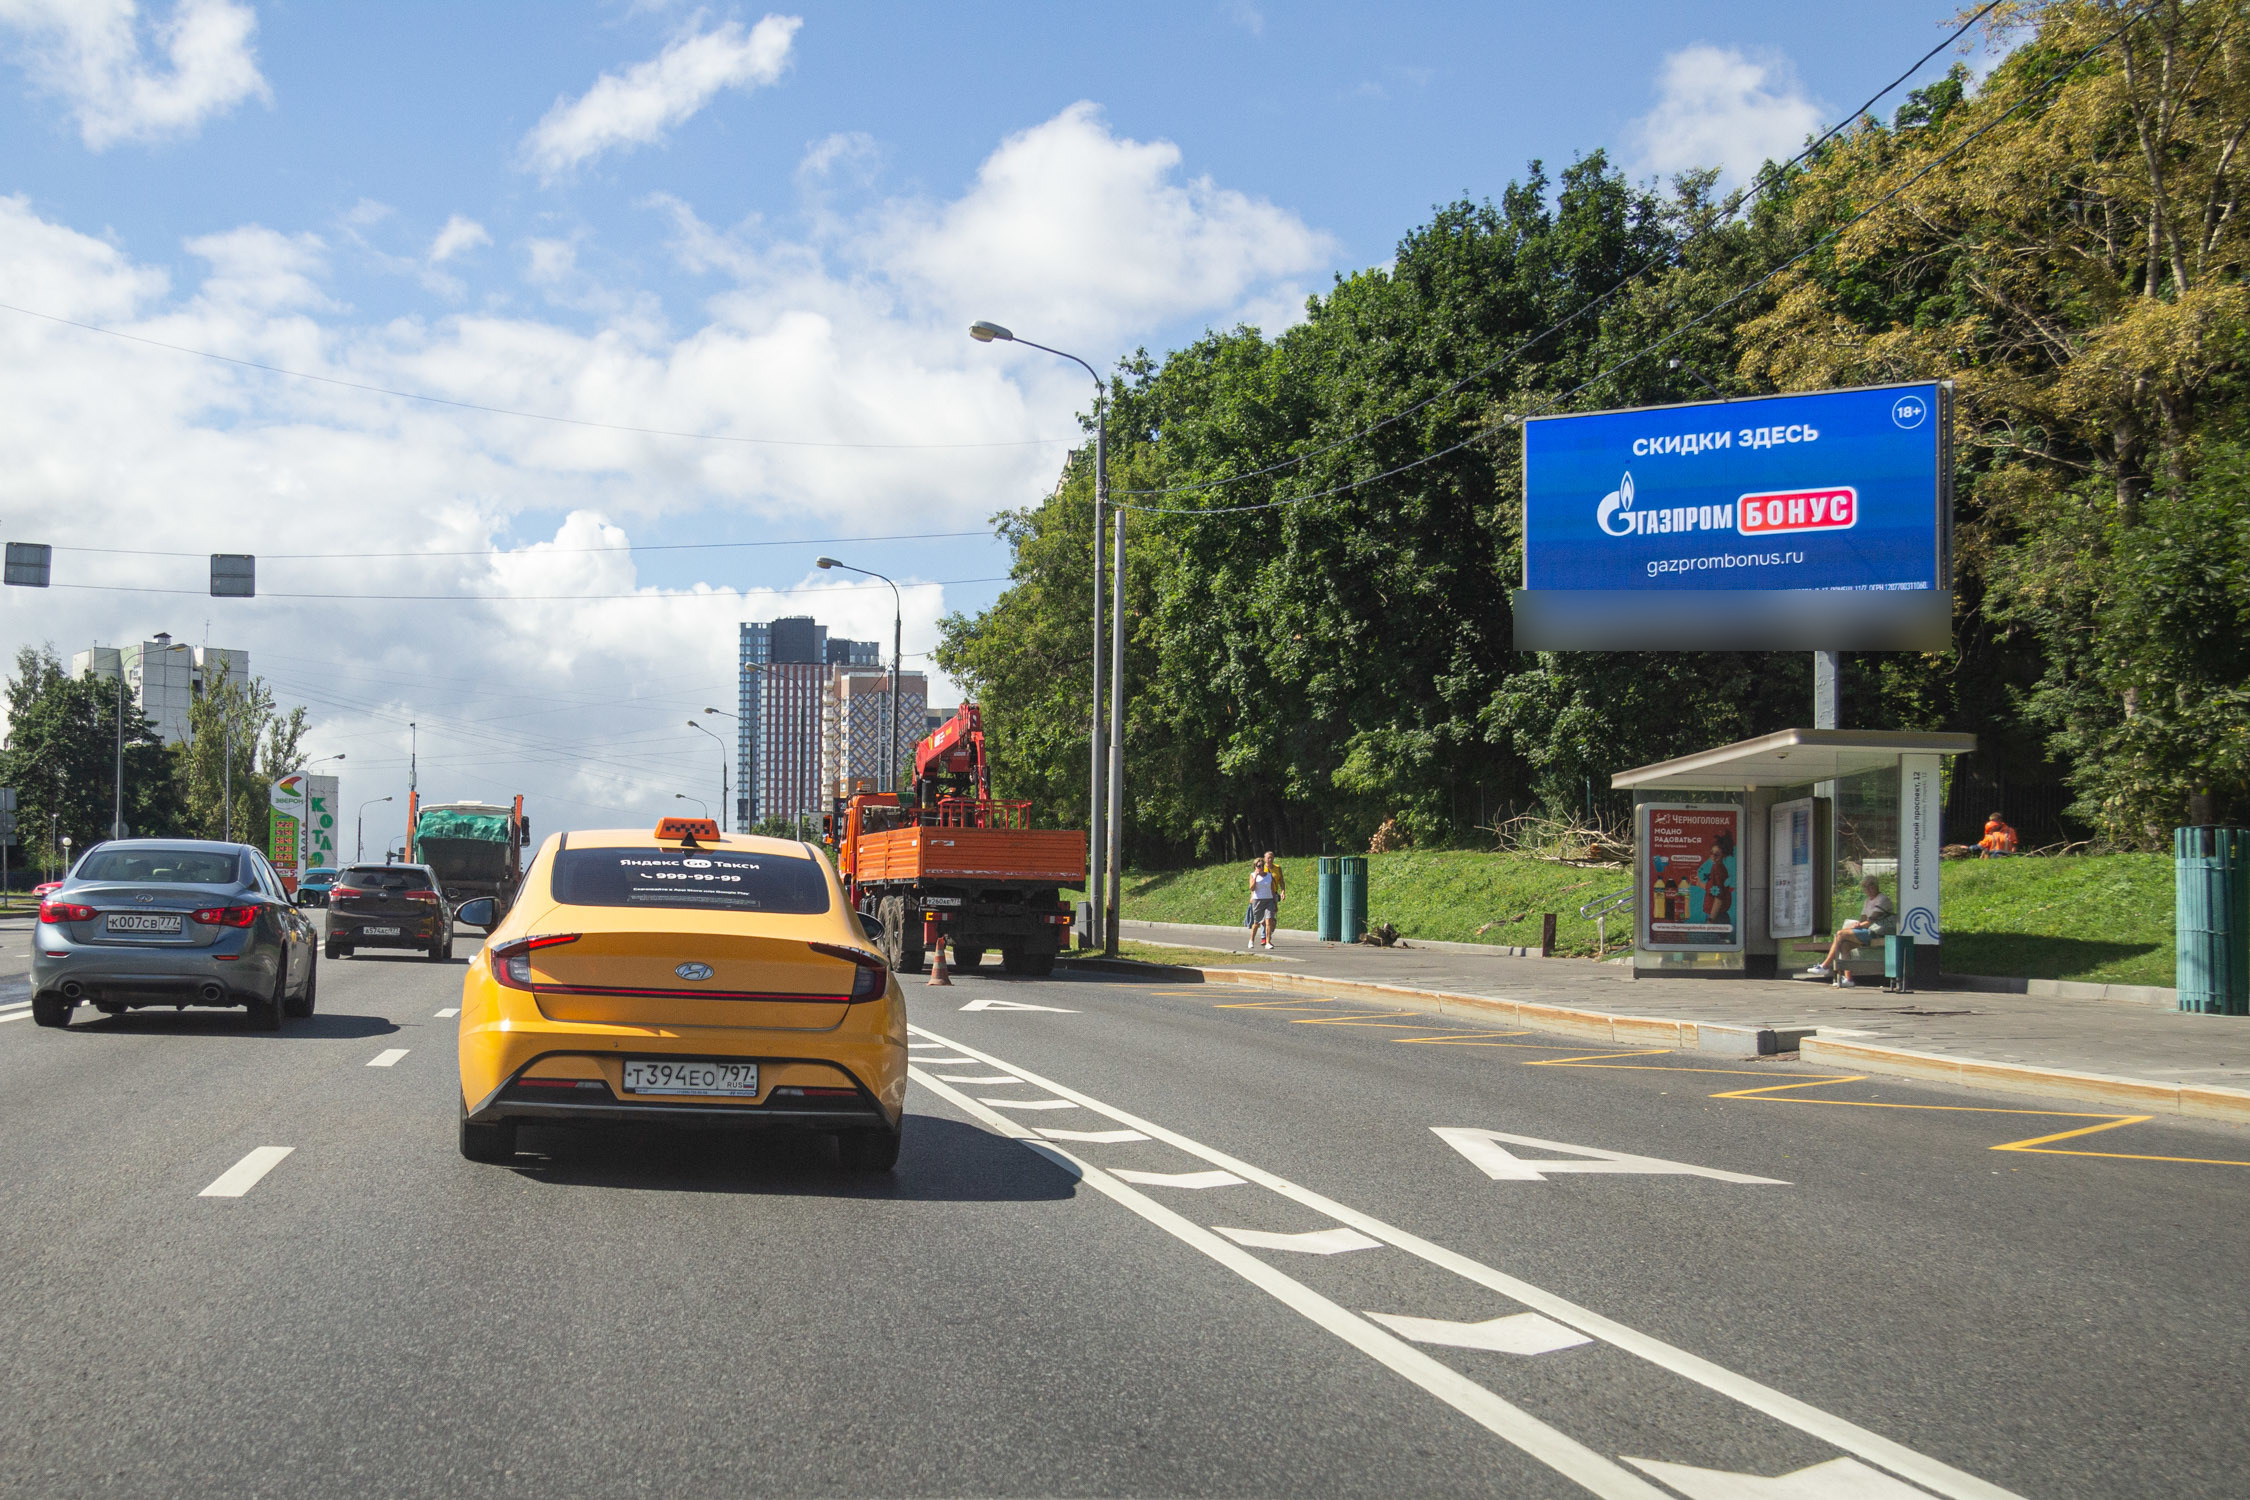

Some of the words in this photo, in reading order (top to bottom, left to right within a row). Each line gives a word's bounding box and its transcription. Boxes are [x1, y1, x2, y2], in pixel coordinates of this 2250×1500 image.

[1897, 406, 1922, 419] 18+
[1632, 431, 1731, 456] СКИДКИ
[1738, 424, 1819, 450] ЗДЕСЬ
[1636, 503, 1733, 536] ГАЗПРОМ
[1745, 495, 1848, 528] БОНУС
[1646, 551, 1804, 578] gazprombonus.ru
[1913, 771, 1920, 781] 12
[1913, 782, 1921, 820] проспект,
[1654, 836, 1702, 844] РАДОВАТЬСЯ
[620, 859, 680, 867] Яндекс
[714, 861, 760, 870] Такси
[1912, 821, 1920, 890] Севастопольский
[656, 872, 741, 882] 999-99-99
[111, 916, 158, 929] К007СВ
[160, 917, 177, 927] 777
[633, 1064, 715, 1087] Т394ЕО
[720, 1065, 752, 1082] 797
